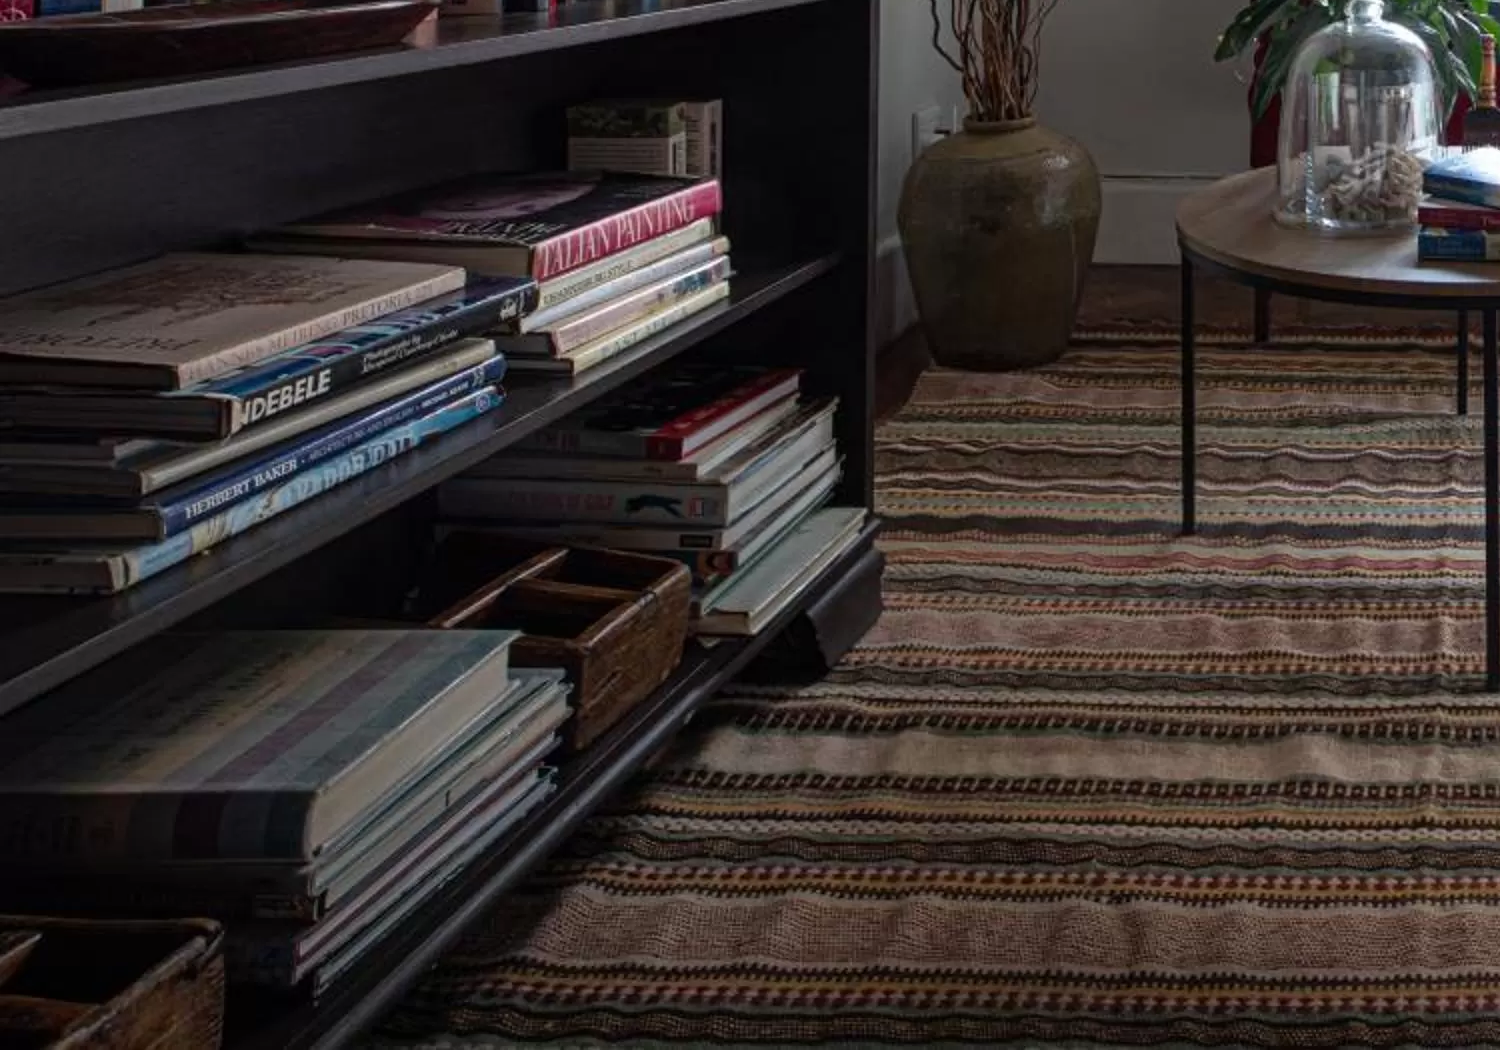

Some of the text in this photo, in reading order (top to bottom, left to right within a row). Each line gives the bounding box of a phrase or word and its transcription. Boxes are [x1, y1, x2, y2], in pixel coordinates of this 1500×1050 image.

[616, 195, 695, 256] PAINTING
[184, 456, 299, 520] HERBERT BAKER
